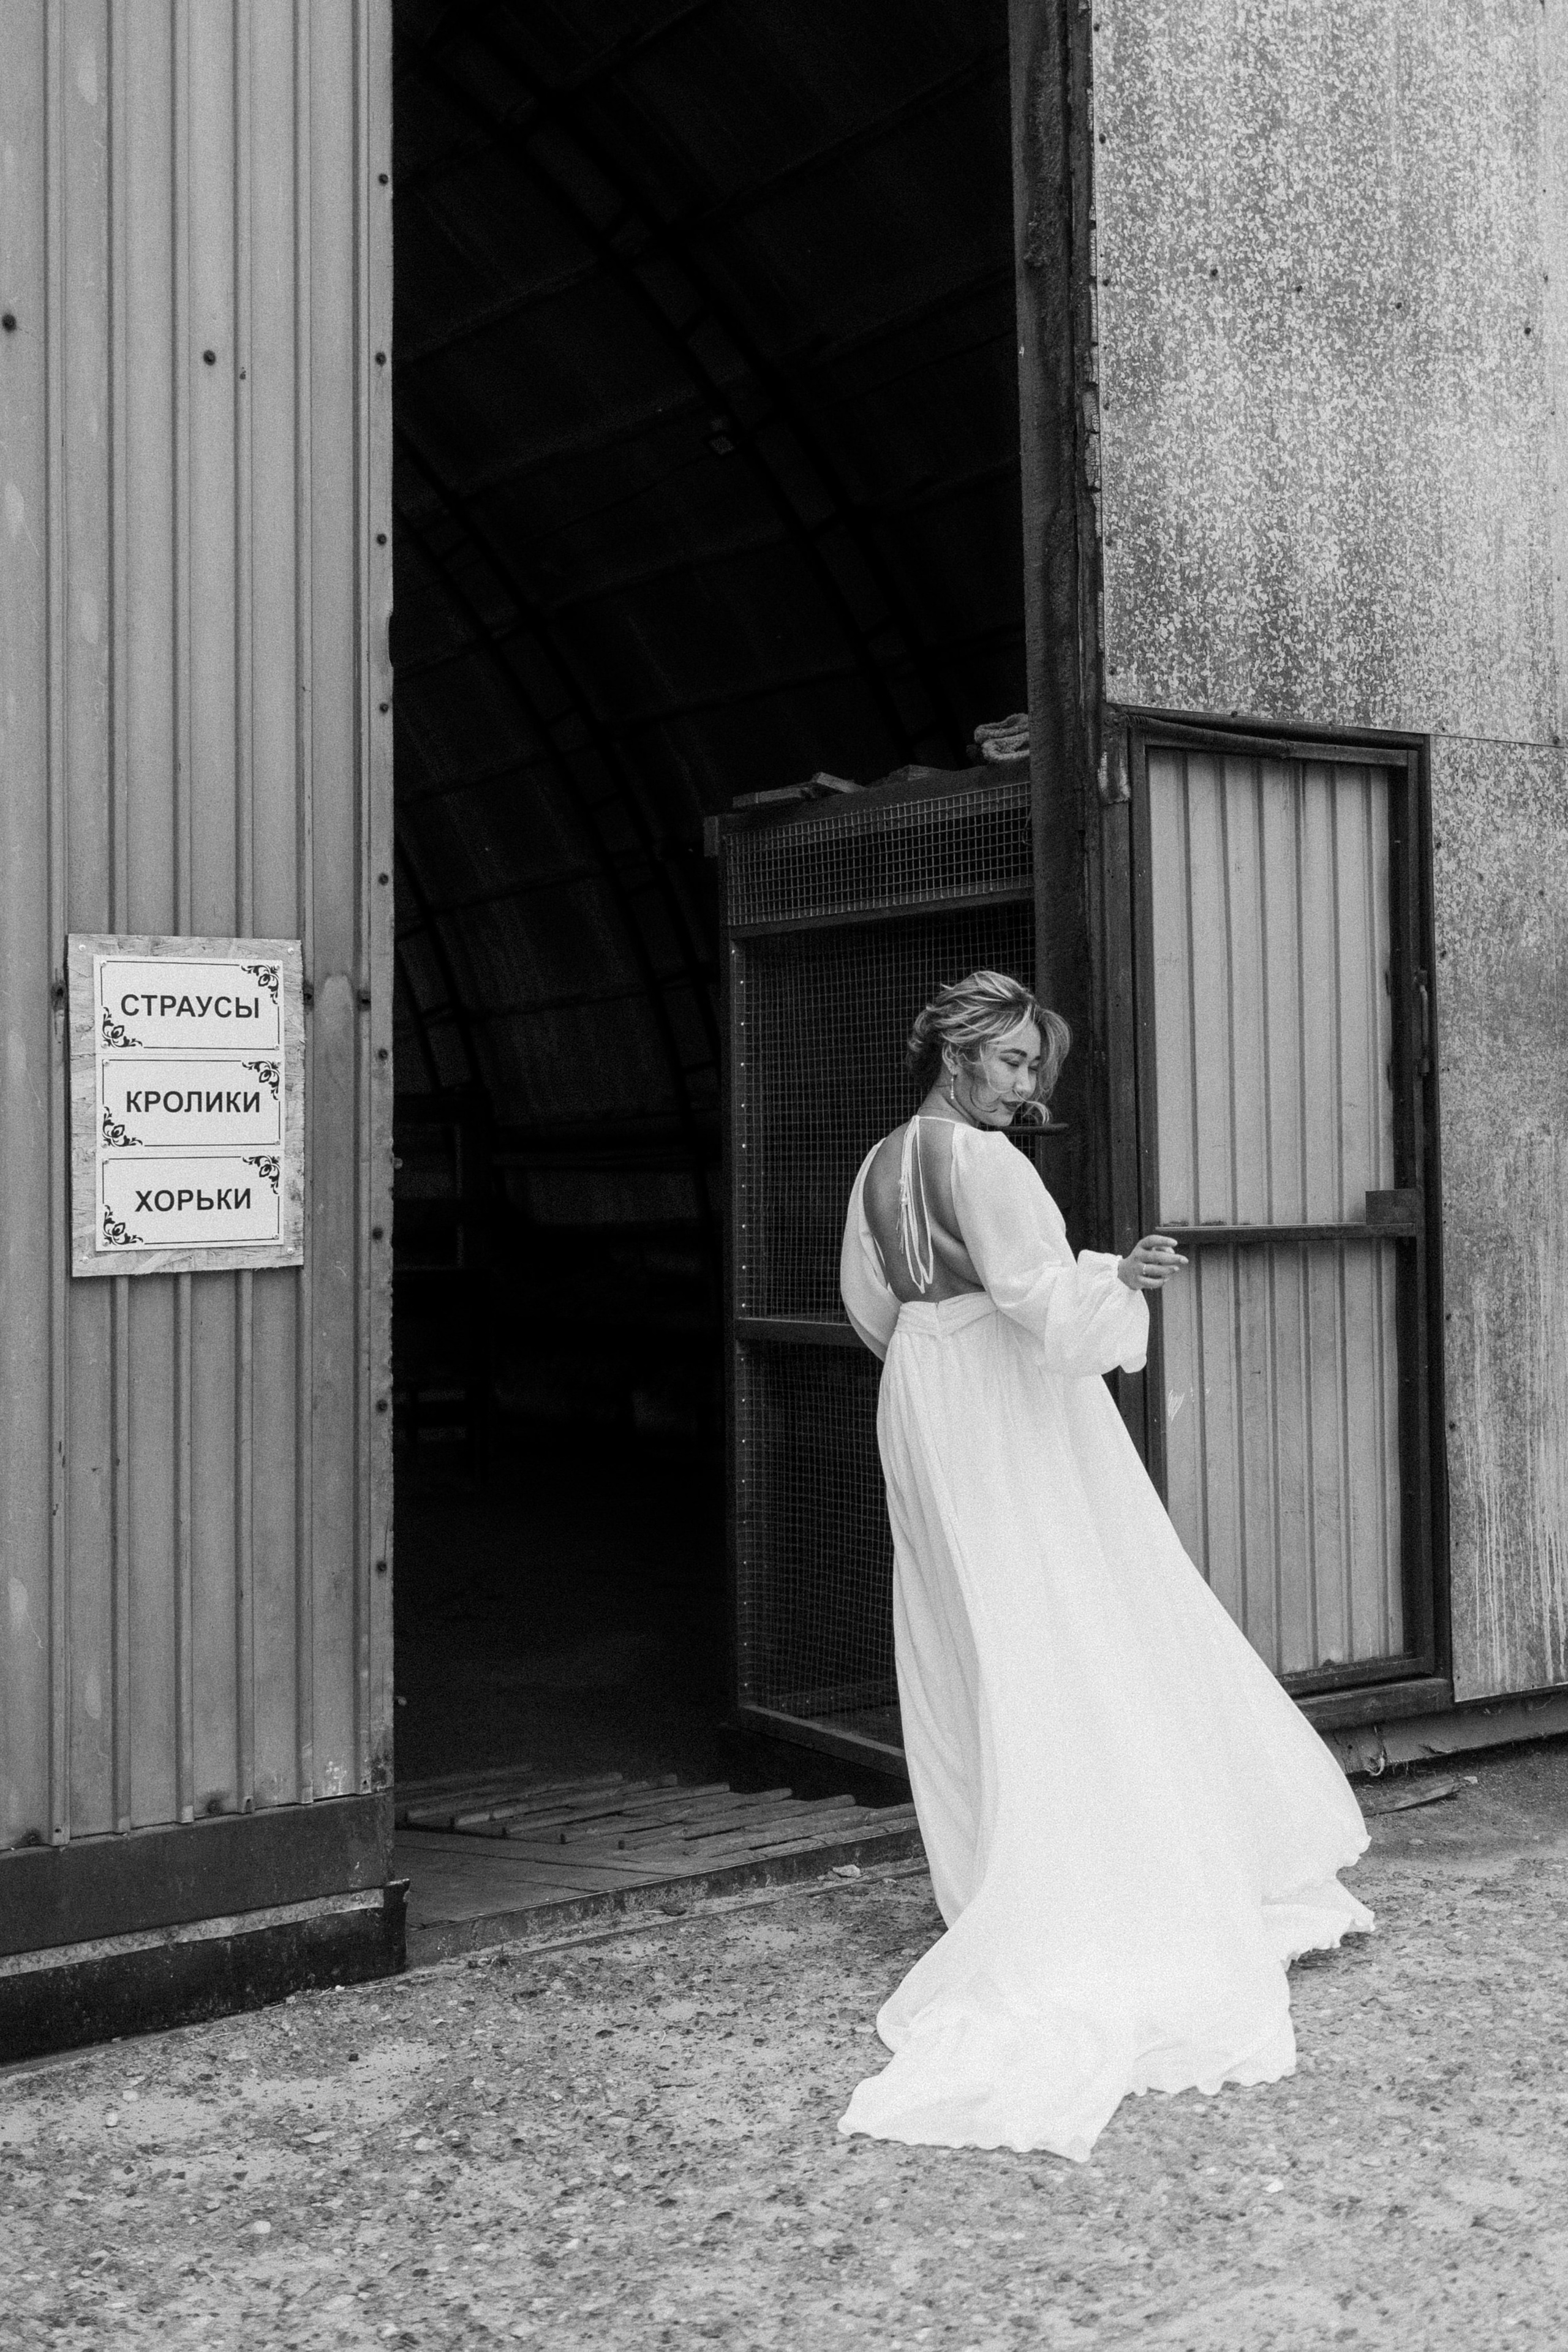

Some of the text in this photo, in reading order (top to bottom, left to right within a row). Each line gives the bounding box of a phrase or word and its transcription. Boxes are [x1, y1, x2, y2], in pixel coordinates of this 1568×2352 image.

[121, 994, 260, 1019] СТРАУСЫ
[126, 1091, 260, 1113] КРОЛИКИ
[134, 1188, 251, 1212] ХОРЬКИ
